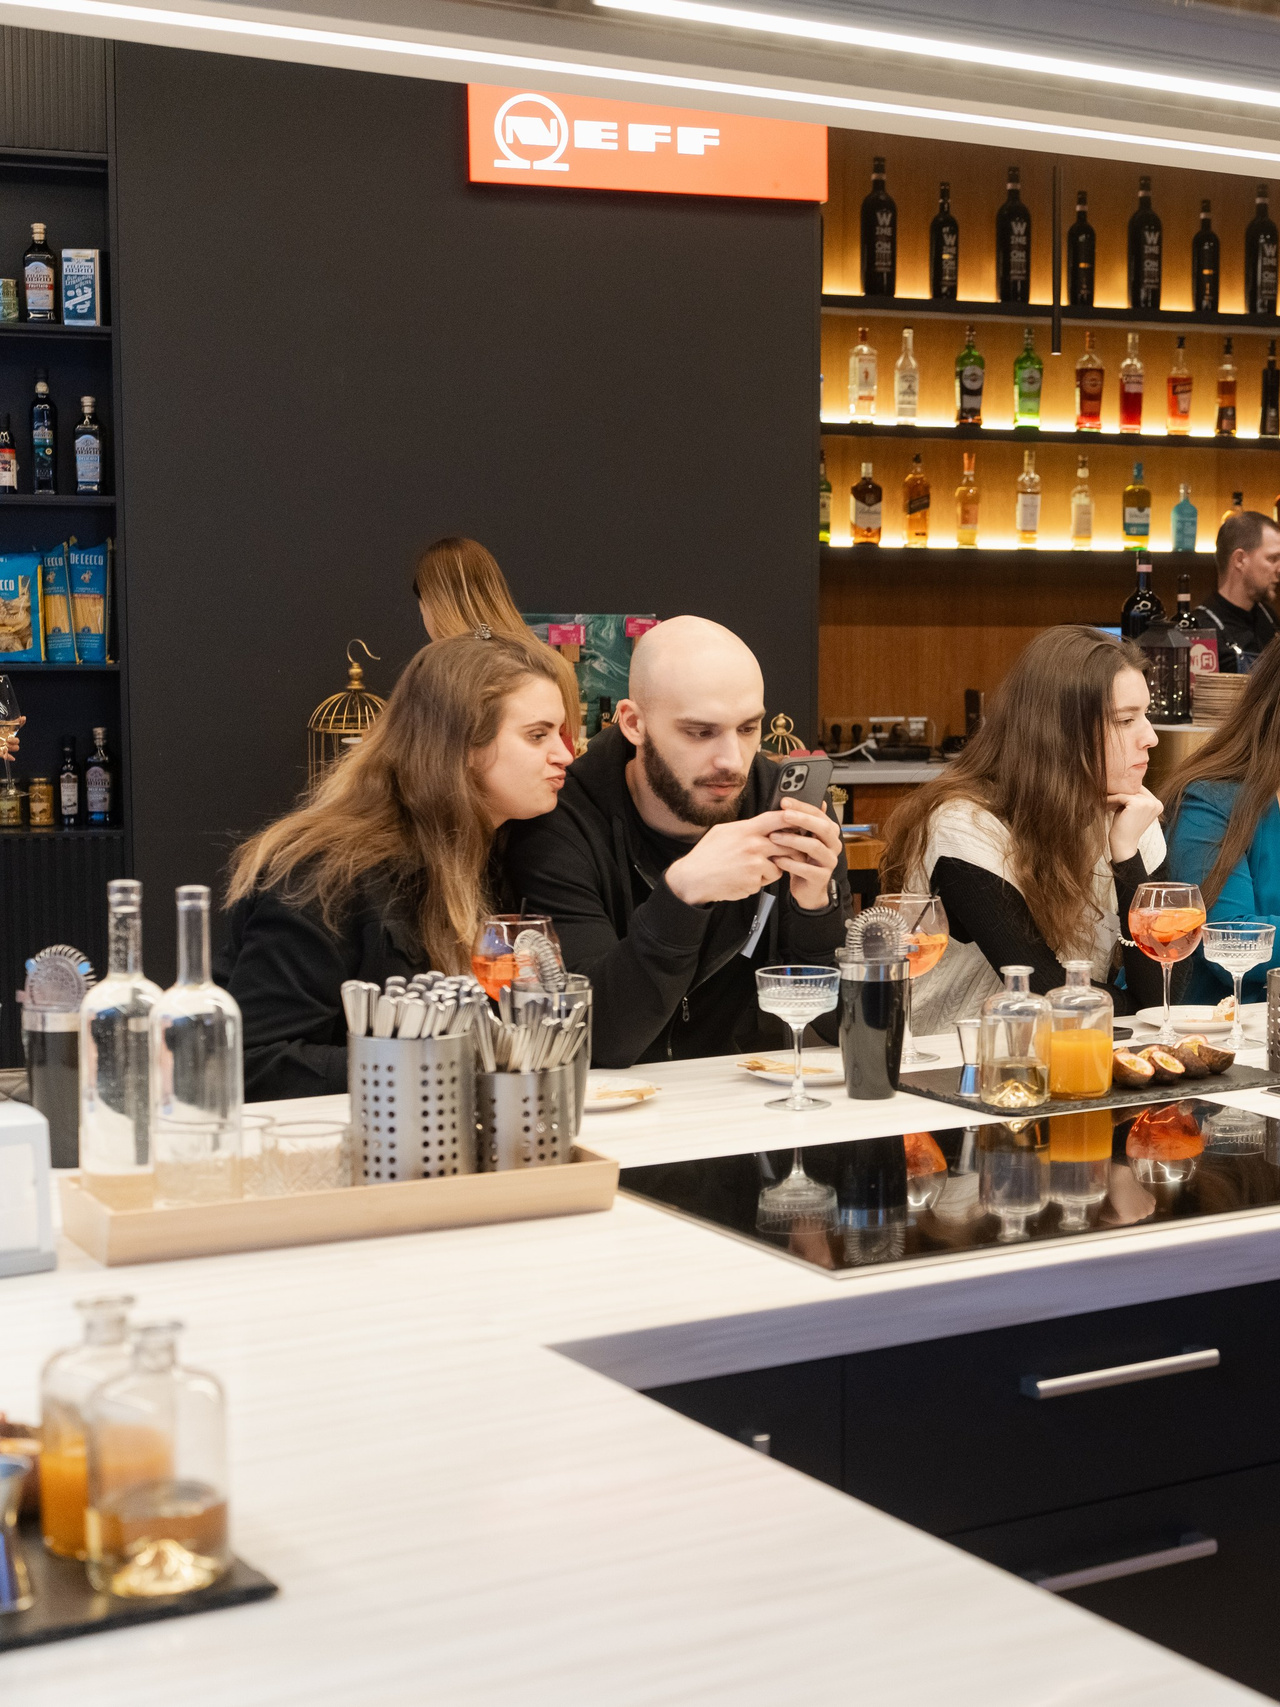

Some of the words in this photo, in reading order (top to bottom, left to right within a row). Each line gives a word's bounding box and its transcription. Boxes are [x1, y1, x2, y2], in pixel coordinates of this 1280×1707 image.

[70, 553, 79, 564] DE
[80, 553, 104, 566] CECCO
[0, 579, 15, 591] CCO
